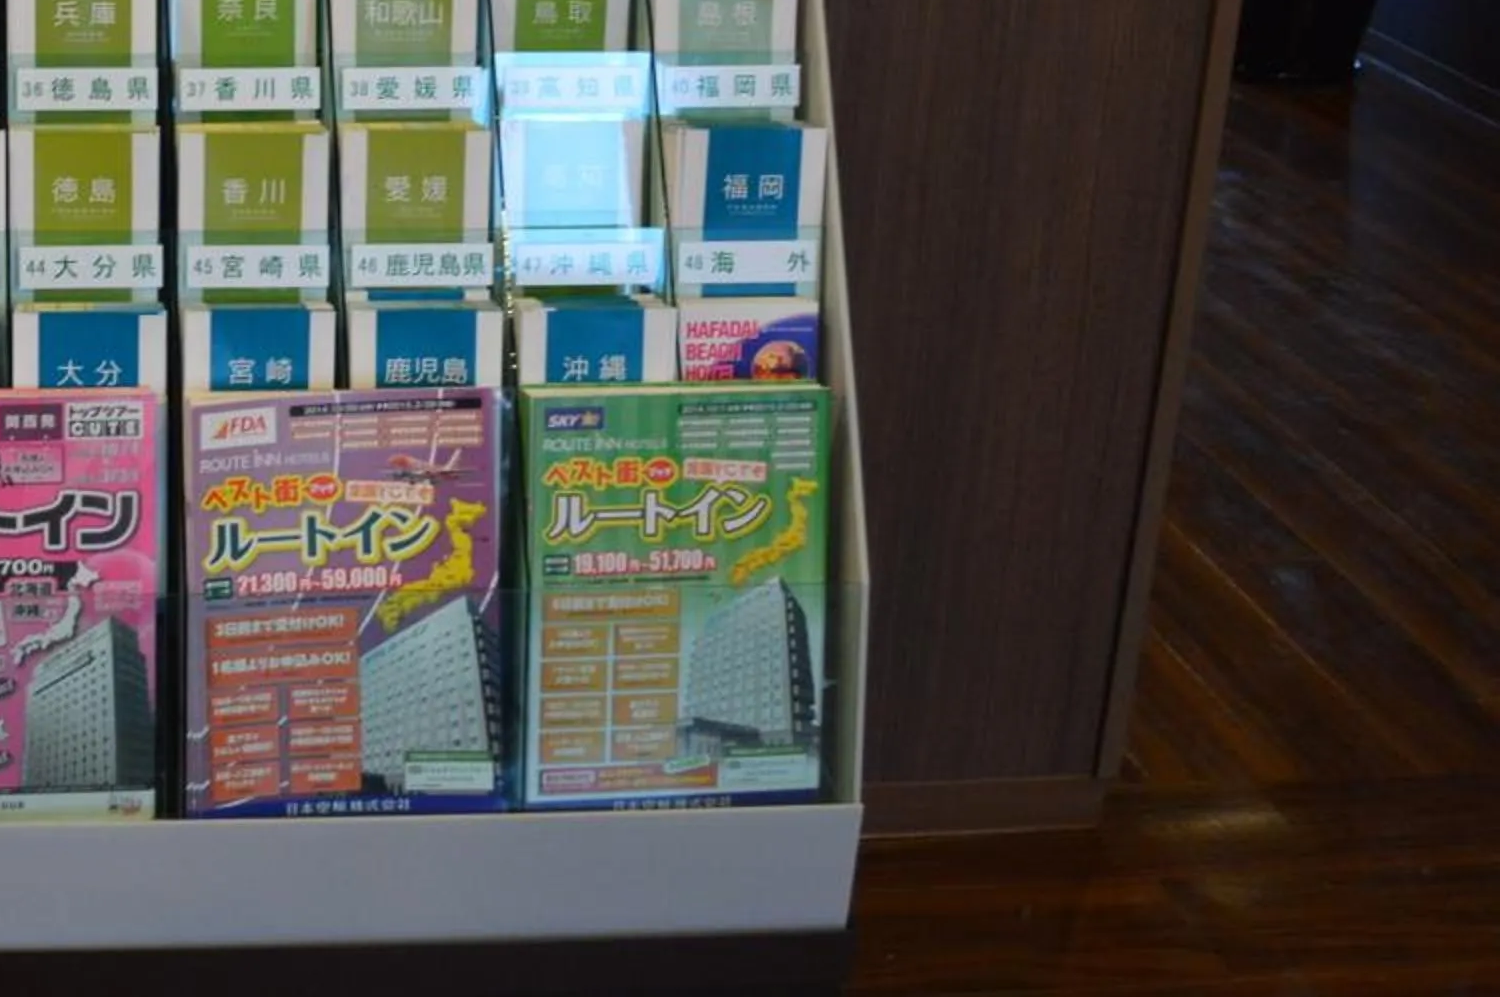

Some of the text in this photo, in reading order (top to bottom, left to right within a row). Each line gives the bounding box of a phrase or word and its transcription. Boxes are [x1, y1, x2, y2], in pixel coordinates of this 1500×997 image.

[53, 0, 116, 28] 兵庫
[364, 0, 444, 27] 和歌山
[534, 0, 592, 24] 鳥取
[51, 75, 150, 101] 徳島県
[214, 75, 314, 100] 香川県
[375, 75, 472, 100] 愛媛県
[700, 73, 793, 99] 福岡県
[51, 176, 116, 204] 徳島
[222, 178, 285, 205] 香川
[383, 175, 448, 203] 愛媛
[723, 173, 785, 200] 福岡
[26, 253, 155, 279] 44 大分県
[222, 253, 322, 280] 宮崎県
[385, 253, 485, 277] 鹿児島県
[57, 359, 122, 386] 大分
[228, 357, 293, 385] 宮崎
[385, 357, 468, 385] 鹿児島
[562, 355, 627, 381] 沖縄
[70, 422, 139, 436] CUTE
[545, 484, 771, 543] ルートイン
[207, 507, 436, 569] ルートイン
